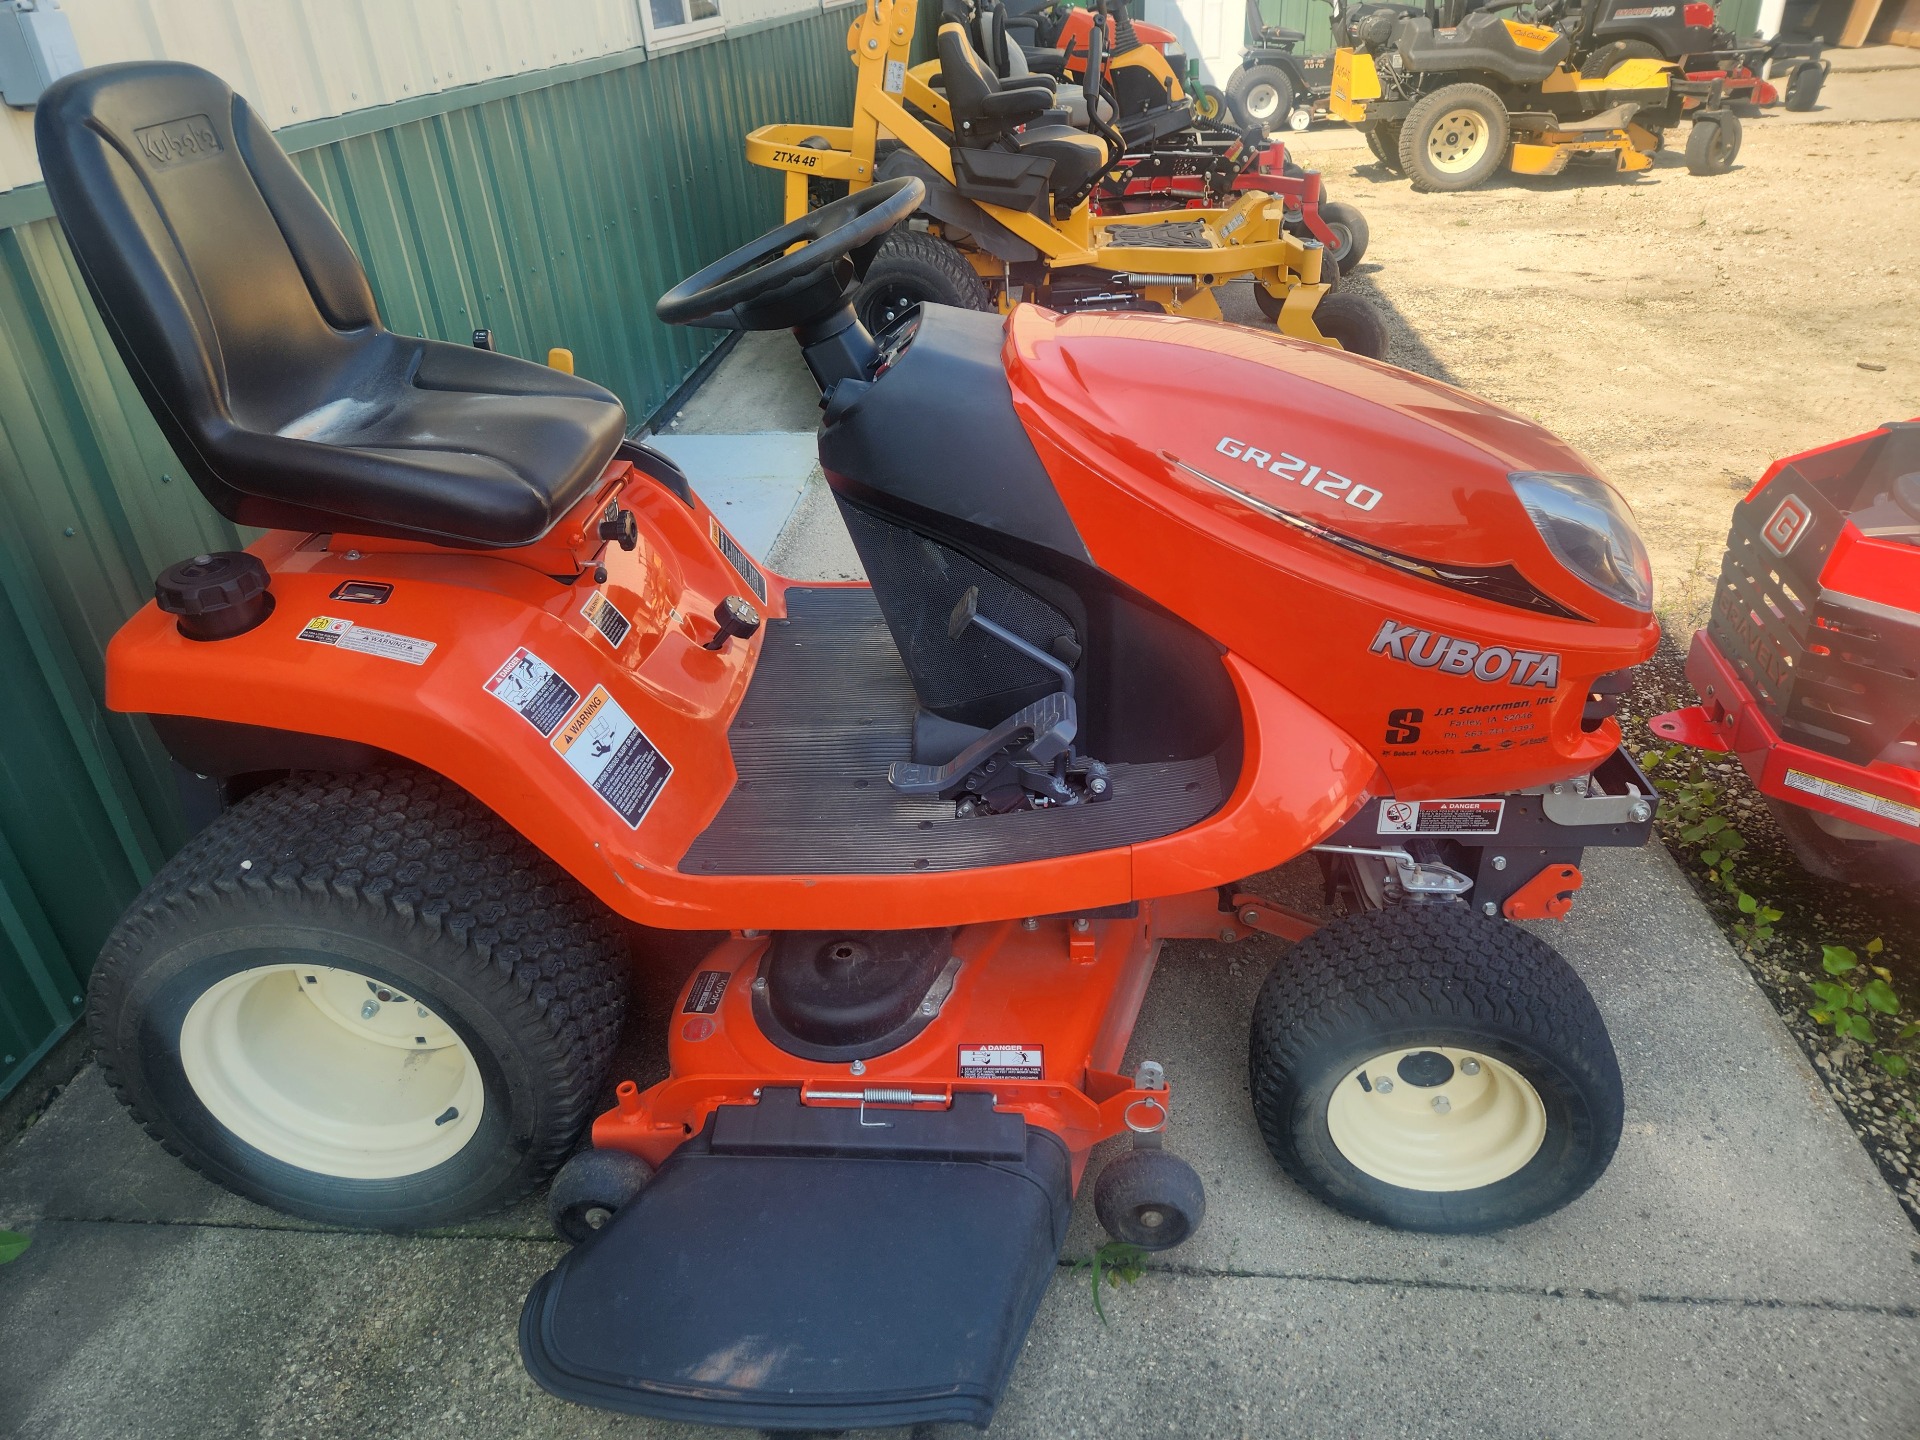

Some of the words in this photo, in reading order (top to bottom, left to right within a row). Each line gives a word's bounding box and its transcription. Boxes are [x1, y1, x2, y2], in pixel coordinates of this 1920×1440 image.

[1650, 6, 1675, 17] PRO
[135, 123, 219, 163] Kubota
[772, 150, 800, 165] ZTX4
[1215, 436, 1384, 511] GR2120
[370, 636, 407, 649] WARNING
[1719, 590, 1790, 689] GRAVELY
[500, 656, 521, 678] DANGER
[1371, 619, 1559, 689] KUBOTA
[569, 696, 602, 735] WARNING
[1458, 700, 1532, 715] Scherrman,
[1536, 695, 1557, 706] Inc.
[709, 979, 727, 1005] Kubota
